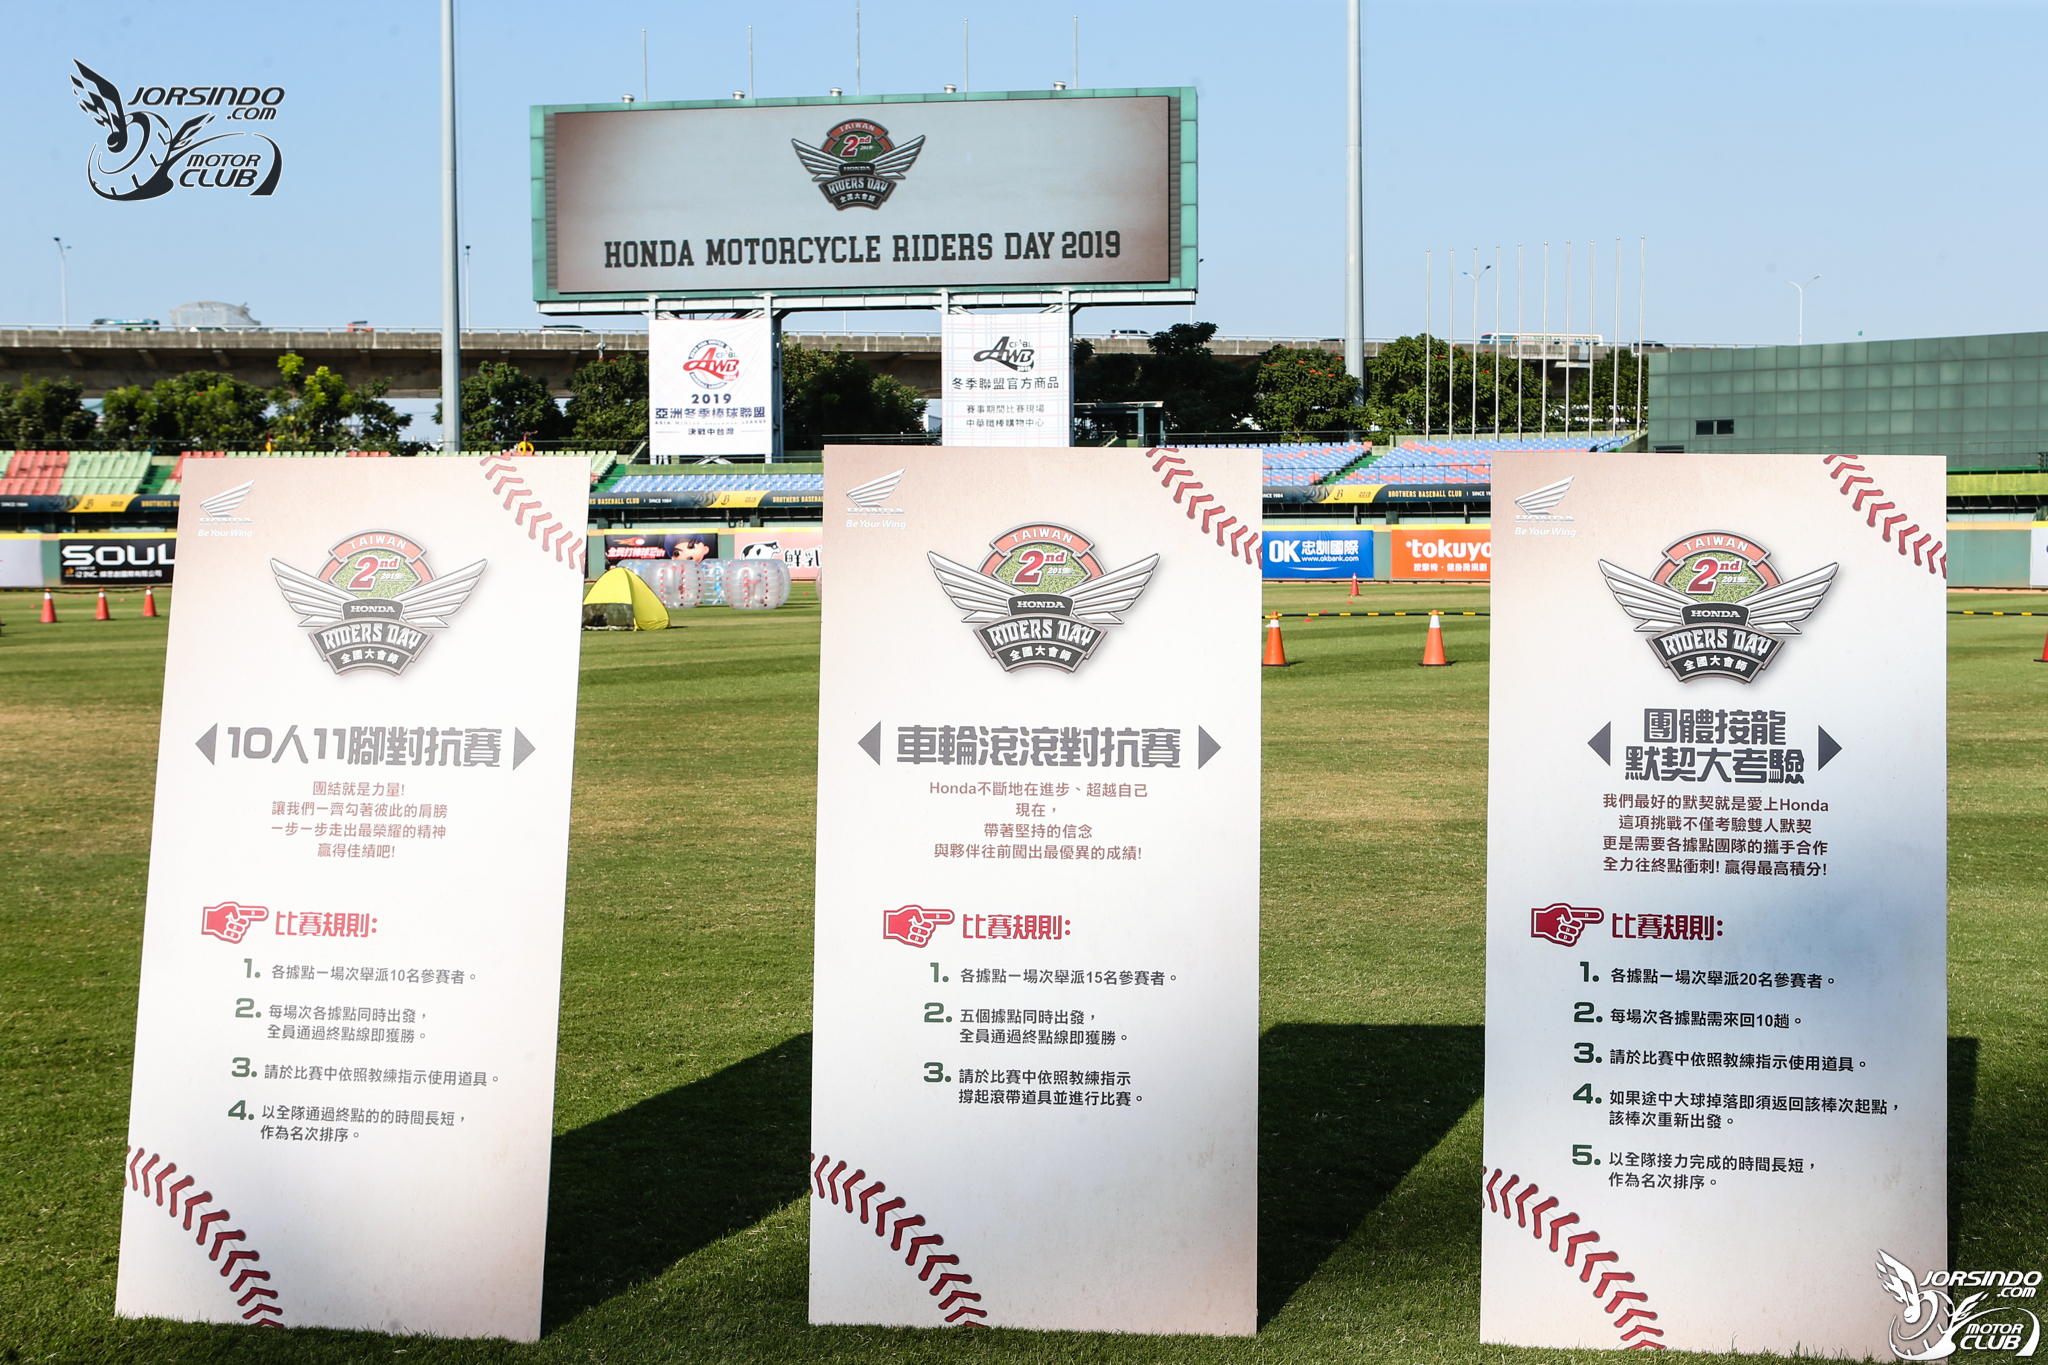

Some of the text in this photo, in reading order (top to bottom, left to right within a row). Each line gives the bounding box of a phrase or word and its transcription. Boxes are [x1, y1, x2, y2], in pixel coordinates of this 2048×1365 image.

[840, 122, 875, 132] TAIWAN
[827, 177, 888, 195] RIDERS DAY
[604, 231, 1120, 268] HONDA MOTORCYCLE RIDERS DAY 2019
[952, 377, 1059, 390] 冬季聯盟官方商品
[692, 394, 732, 404] 2019
[655, 407, 765, 419] 亞洲冬季棒球聯盟
[1388, 490, 1417, 498] BROTHERS
[1418, 490, 1446, 498] BASEBALL
[846, 507, 906, 516] HONDA
[1514, 515, 1576, 523] HONDA
[199, 517, 254, 525] HONDA
[846, 519, 907, 530] Be Your Wing
[198, 529, 253, 539] Be Your Wing
[1010, 528, 1073, 544] TAIWAN
[1514, 527, 1576, 538] Be Your Wing
[348, 535, 407, 550] TAIWAN
[1269, 540, 1301, 562] OK
[1301, 539, 1359, 555] 忠訓國際
[1411, 539, 1491, 561] tokuyo
[1683, 536, 1748, 552] TAIWAN
[61, 543, 175, 566] SOUL
[784, 548, 822, 567] 鮮乳
[1301, 554, 1359, 562] www.okbank.com
[348, 555, 400, 590] 2nd
[1012, 549, 1067, 585] 2nd
[1686, 557, 1742, 594] 2nd
[350, 605, 395, 613] HONDA
[1690, 610, 1741, 618] HONDA
[320, 623, 422, 650] RIDERS DAY
[987, 619, 1096, 646] RIDERS DAY
[1660, 629, 1772, 656] RIDERS DAY
[341, 648, 400, 664] 全國大會師
[1009, 645, 1072, 661] 全國大會師
[1683, 655, 1748, 672] 全國大會師
[1644, 708, 1786, 745] 團體接龍
[228, 725, 502, 767] 10人11腳對抗賽
[897, 725, 1181, 768] 車輪滾滾對抗賽
[1625, 746, 1804, 784] 默契大考驗
[313, 781, 404, 797] 團結就是力量!
[930, 781, 1147, 797] Honda不斷地在進步、超越自己
[272, 801, 447, 818] 讓我們一齊勾著彼此的肩膀
[1603, 793, 1828, 811] 我們最好的默契就是愛上Honda
[272, 822, 446, 839] 一步一步走出最榮耀的精神
[984, 823, 1092, 839] 帶著堅持的信念
[1619, 815, 1811, 834] 這項挑戰不僅考驗雙人默契
[1603, 836, 1828, 855] 更是需要各據點團隊的攜手合作
[244, 958, 475, 984] 1. 各據點一場次舉派10名參賽者。
[930, 962, 1176, 986] 1. 各據點一場次舉派15名參賽者。
[1580, 961, 1834, 989] 1. 各據點一場次舉派20名參賽者。
[235, 998, 425, 1024] 2. 每場次各據點同時出發，
[924, 1002, 1094, 1025] 2. 五個據點同時出發，
[1574, 1002, 1801, 1028] 2. 每場次各據點需來回10趟。
[267, 1024, 425, 1043] 全員通過終點線即獲勝。
[960, 1029, 1127, 1045] 全員通過終點線即獲勝。
[1574, 1042, 1866, 1072] 3. 請於比賽中依照教練指示使用道具。
[232, 1057, 498, 1086] 3. 請於比賽中依照教練指示使用道具。
[924, 1062, 1131, 1086] 3. 請於比賽中依照教練指示
[959, 1089, 1142, 1106] 撐起滾帶道具並進行比賽。
[1573, 1083, 1898, 1115] 4. 如果途中大球掉落即須返回該棒次起點，
[228, 1100, 465, 1126] 4. 以全隊通過終點的的時間長短，
[1609, 1110, 1733, 1129] 該棒次重新出發。
[260, 1125, 359, 1142] 作為名次排序。
[1572, 1144, 1815, 1173] 5. 以全隊接力完成的時間長短，
[1609, 1173, 1716, 1190] 作為名次排序。
